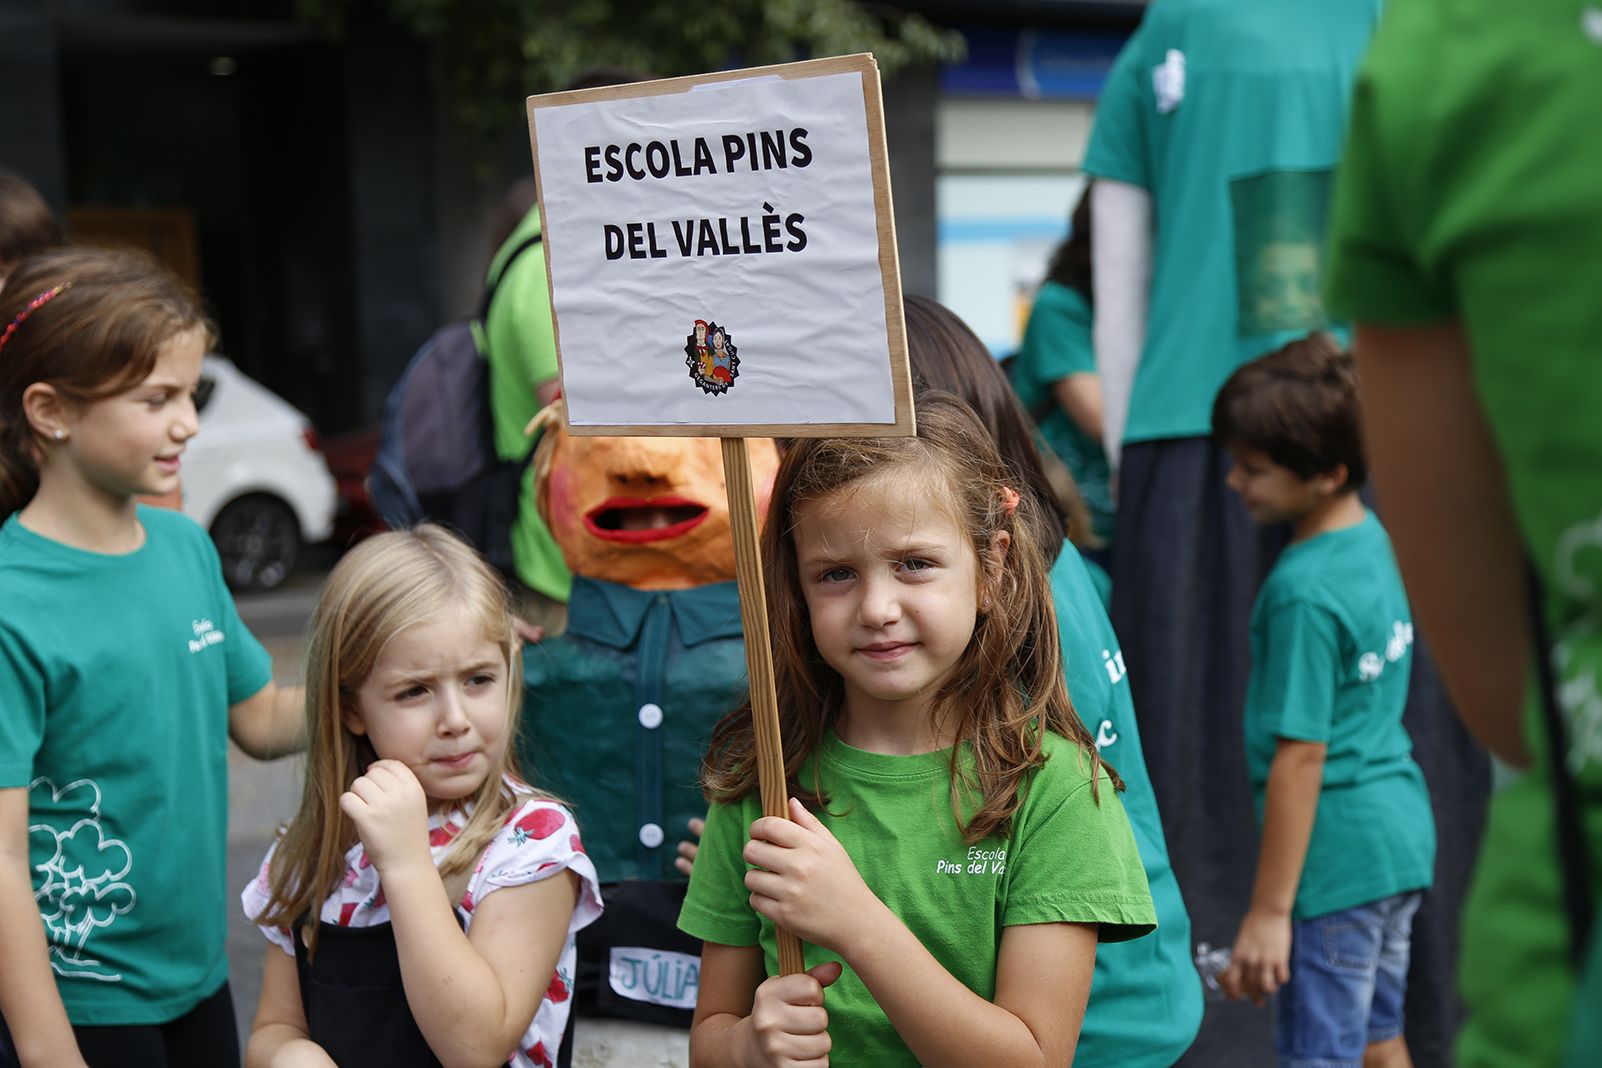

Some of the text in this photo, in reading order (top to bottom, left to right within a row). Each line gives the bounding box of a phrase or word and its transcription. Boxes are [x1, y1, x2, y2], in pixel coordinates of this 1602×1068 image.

[584, 127, 813, 184] ESCOLA PINS
[604, 201, 808, 261] DEL VALLÈS
[936, 859, 962, 874] Pins
[967, 859, 987, 874] del
[967, 846, 1006, 860] Escola
